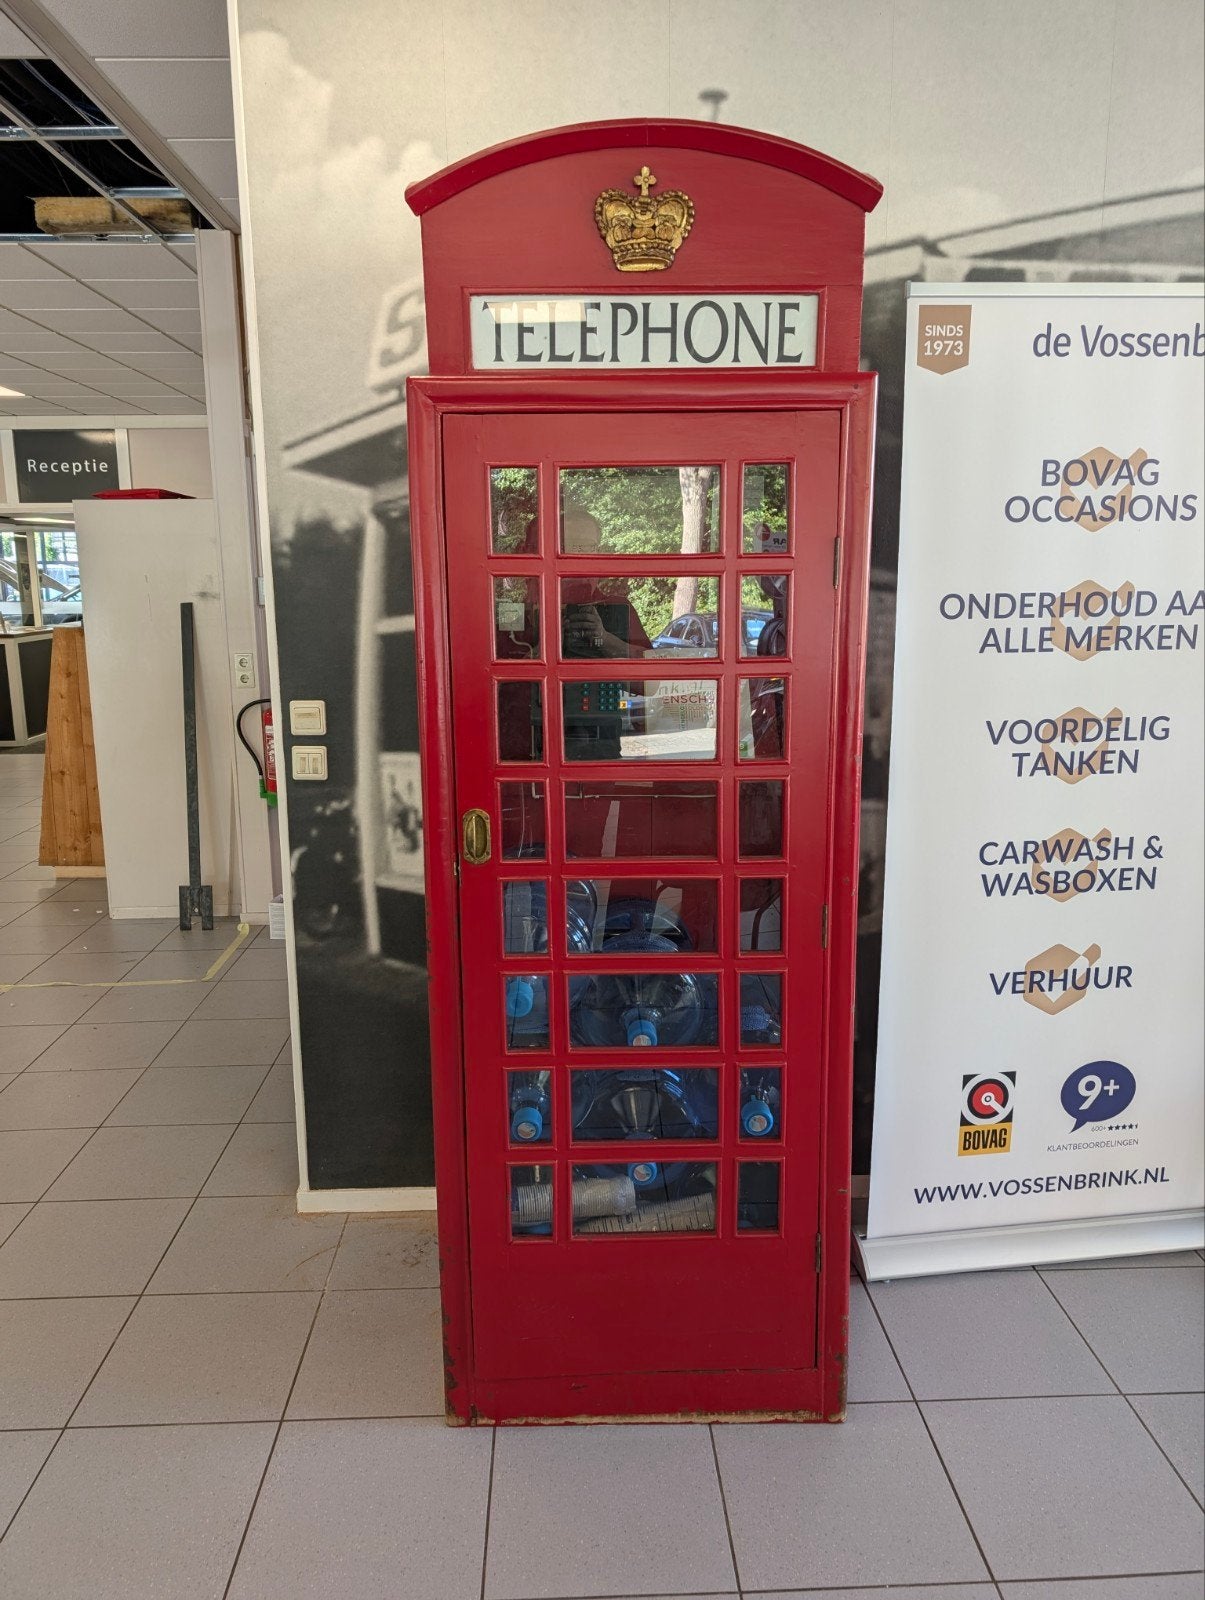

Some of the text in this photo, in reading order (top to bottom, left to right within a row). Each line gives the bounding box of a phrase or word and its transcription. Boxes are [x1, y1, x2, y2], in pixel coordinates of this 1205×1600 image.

[482, 299, 803, 366] TELEPHONE
[924, 324, 964, 337] SINDS
[1032, 322, 1072, 358] de
[924, 340, 964, 356] 1973
[27, 458, 109, 475] Receptie
[1041, 458, 1160, 487] BOVAG
[1004, 494, 1198, 523] OCCASIONS
[939, 590, 1158, 620] ONDERHOUD
[978, 624, 1199, 654] ALLE MERKEN
[985, 716, 1171, 745] VOORDELIG
[1011, 749, 1140, 777] TANKEN
[978, 835, 1163, 866] CARWASH &
[980, 866, 1157, 897] WASBOXEN
[989, 965, 1133, 995] VERHUUR
[1077, 1074, 1120, 1111] 9+
[962, 1127, 1008, 1151] BOVAG
[1047, 1138, 1139, 1152] KLANTBEOORDELINGEN
[914, 1166, 1170, 1204] WWW.VOSSENBRINK.NL
